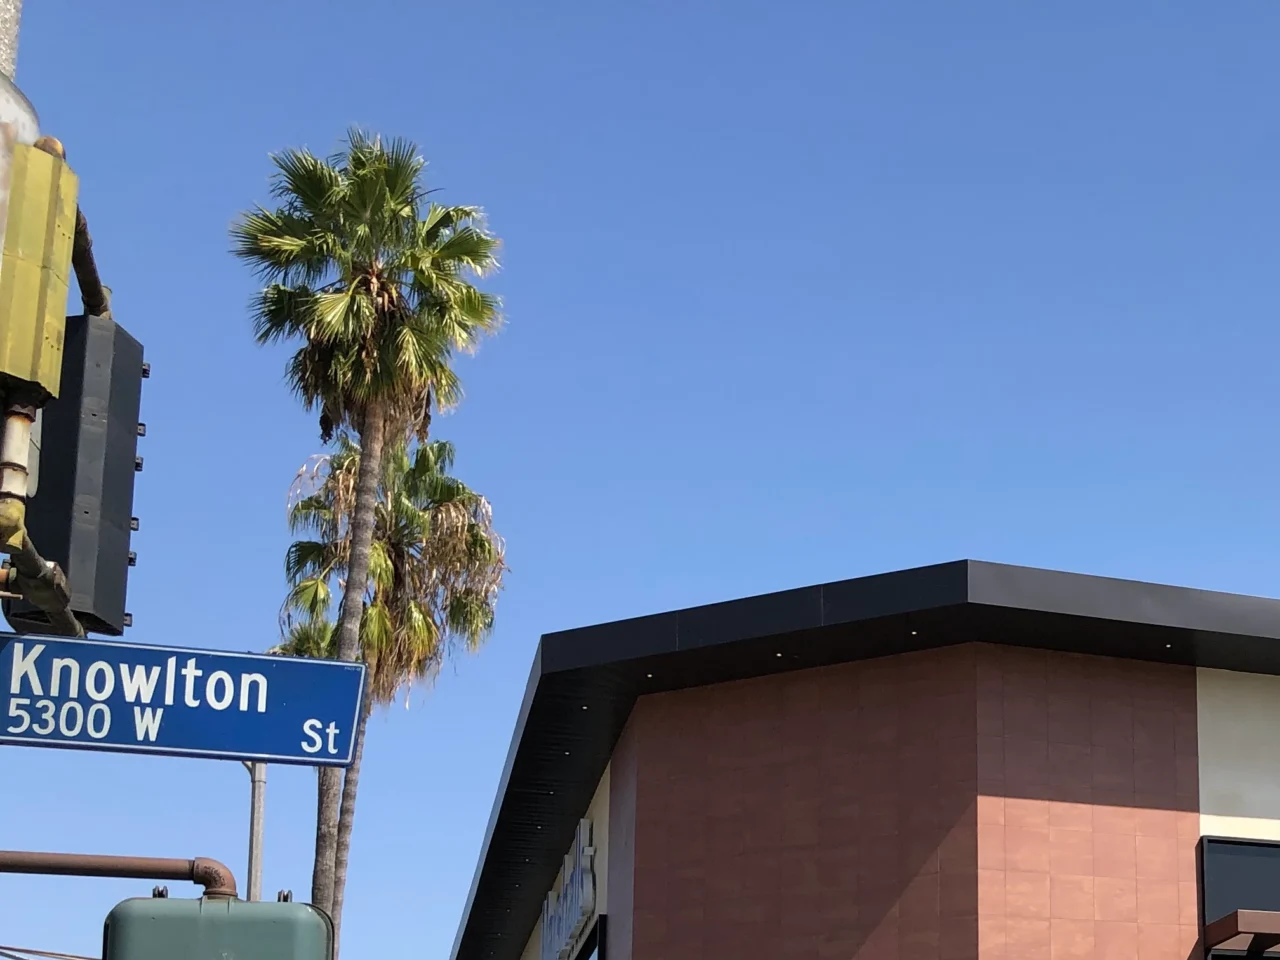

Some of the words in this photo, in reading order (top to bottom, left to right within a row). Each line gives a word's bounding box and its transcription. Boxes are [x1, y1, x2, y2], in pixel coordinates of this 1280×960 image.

[9, 642, 269, 713] Knowlton
[6, 697, 112, 739] 5300
[133, 706, 164, 742] W
[300, 718, 340, 755] St
